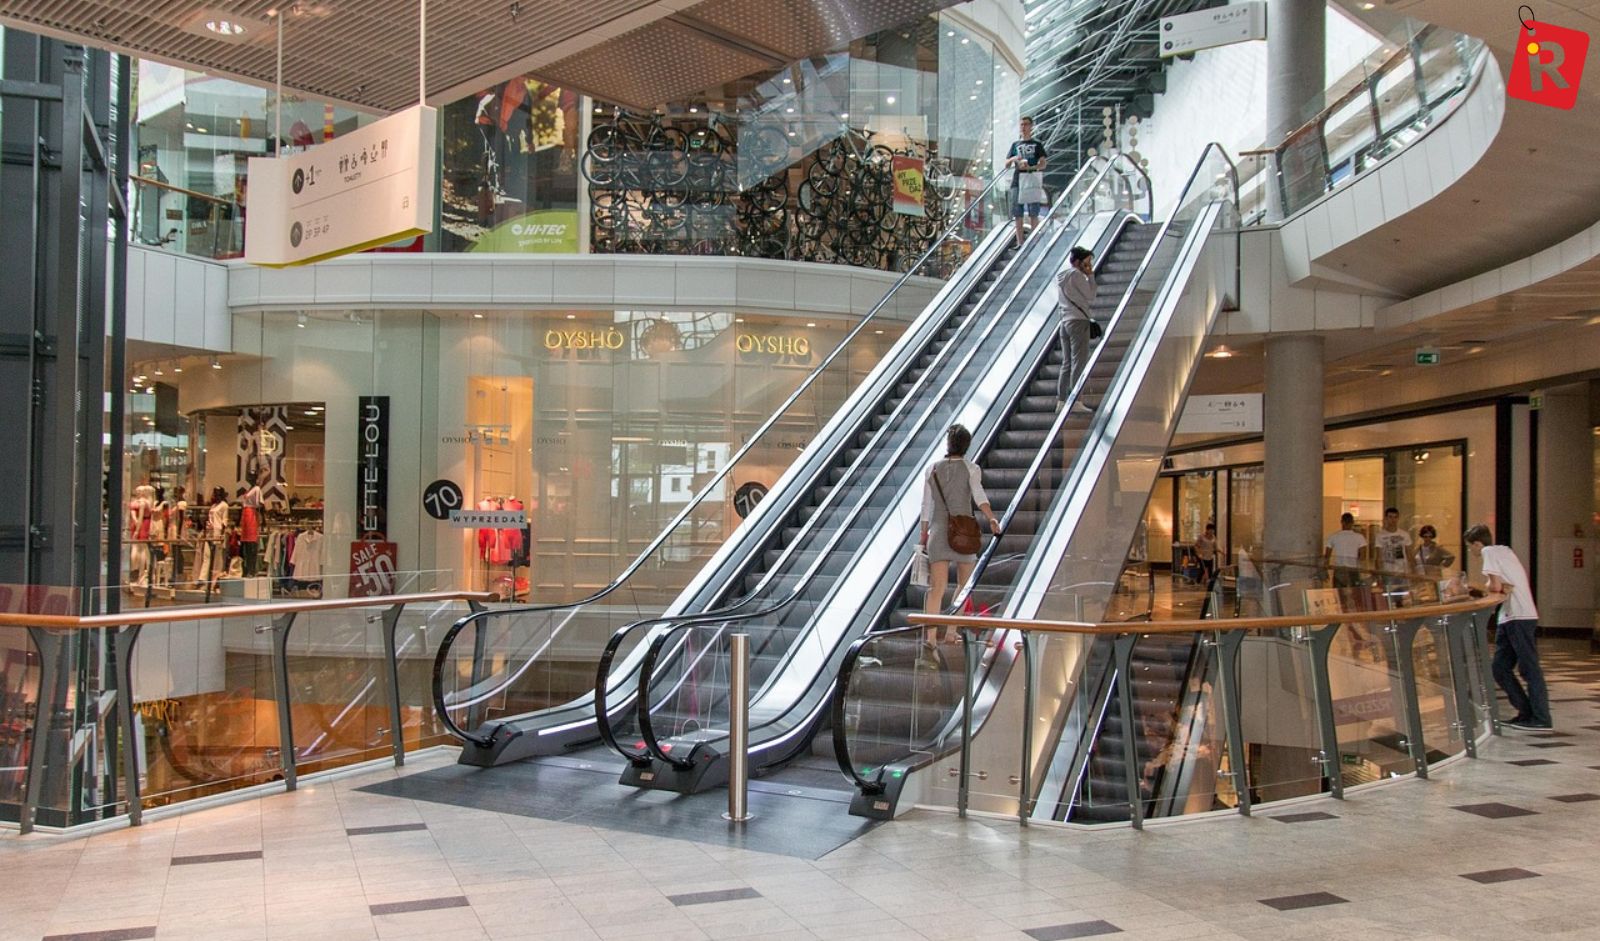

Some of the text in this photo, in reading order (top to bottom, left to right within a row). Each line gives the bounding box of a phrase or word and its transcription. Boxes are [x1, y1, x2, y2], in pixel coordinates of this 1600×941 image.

[523, 224, 566, 235] HI-TEC
[545, 330, 624, 349] OYSHO
[736, 334, 810, 355] OYSHO
[364, 404, 380, 458] LOU
[452, 515, 526, 524] WYPRZEDAŻ
[352, 543, 378, 565] SALE
